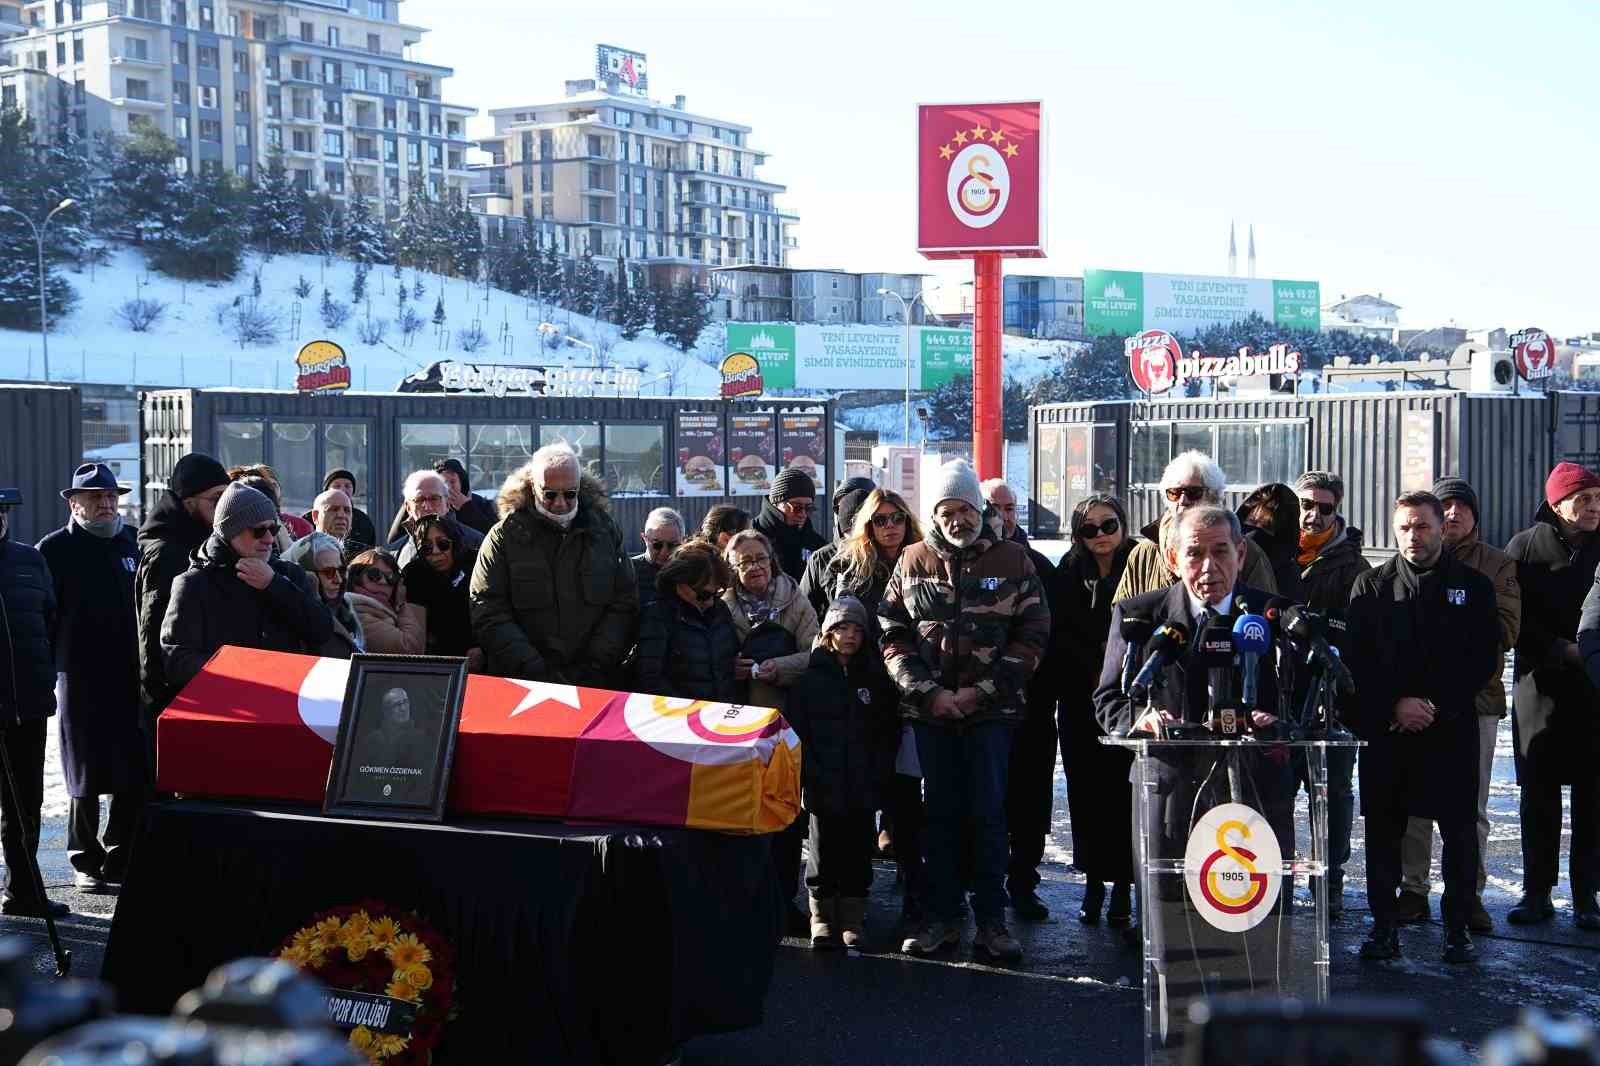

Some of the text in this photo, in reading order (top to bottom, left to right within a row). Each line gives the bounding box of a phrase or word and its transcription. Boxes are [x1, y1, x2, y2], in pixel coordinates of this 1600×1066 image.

[1125, 333, 1171, 356] pizza
[1511, 330, 1546, 348] pizza
[1176, 344, 1300, 385] pizzabulls
[359, 765, 423, 775] GÖKMEN ÖZDENAK
[1222, 872, 1244, 881] 1905
[328, 997, 353, 1022] SPOR
